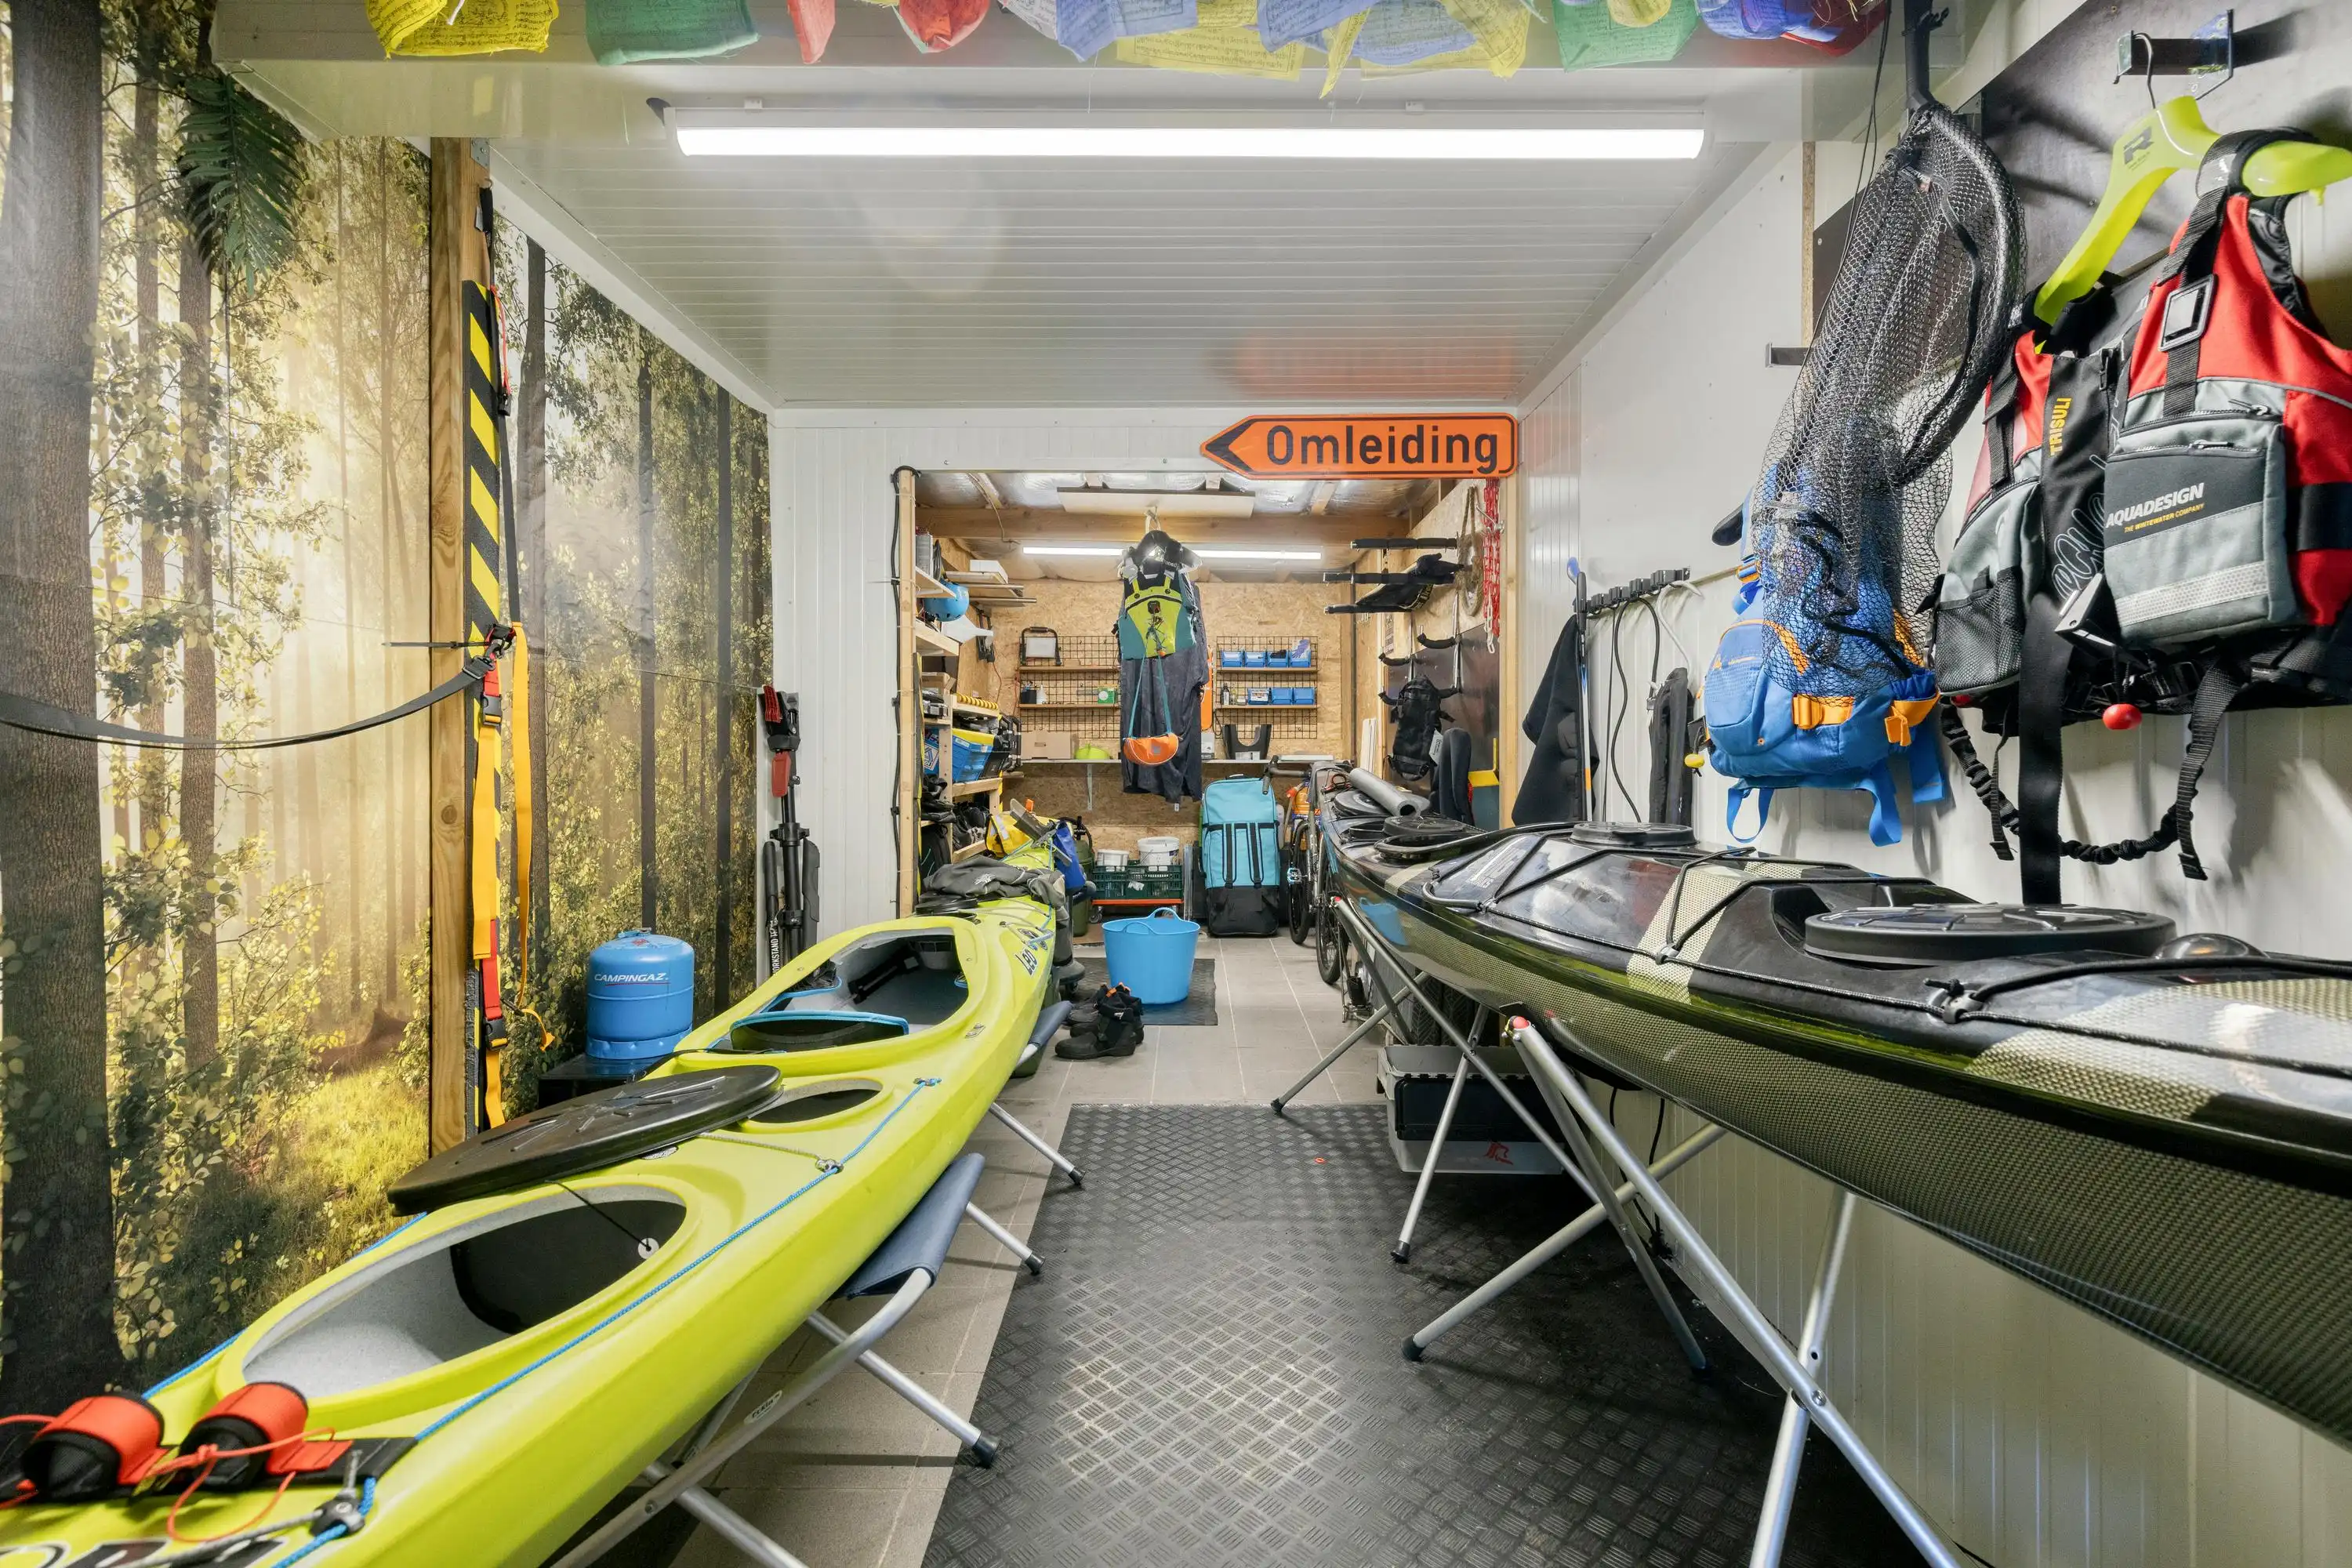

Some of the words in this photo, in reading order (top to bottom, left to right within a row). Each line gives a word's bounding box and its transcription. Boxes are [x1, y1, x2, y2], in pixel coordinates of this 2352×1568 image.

[2049, 397, 2072, 456] TRISULI
[1266, 424, 1498, 474] Omleiding
[2105, 482, 2205, 528] AQUADESIGN
[2135, 512, 2175, 531] WHITEWATER
[2175, 503, 2205, 517] COMPANY
[771, 938, 781, 974] ORKSTAND
[593, 972, 667, 983] CAMPINGAZ
